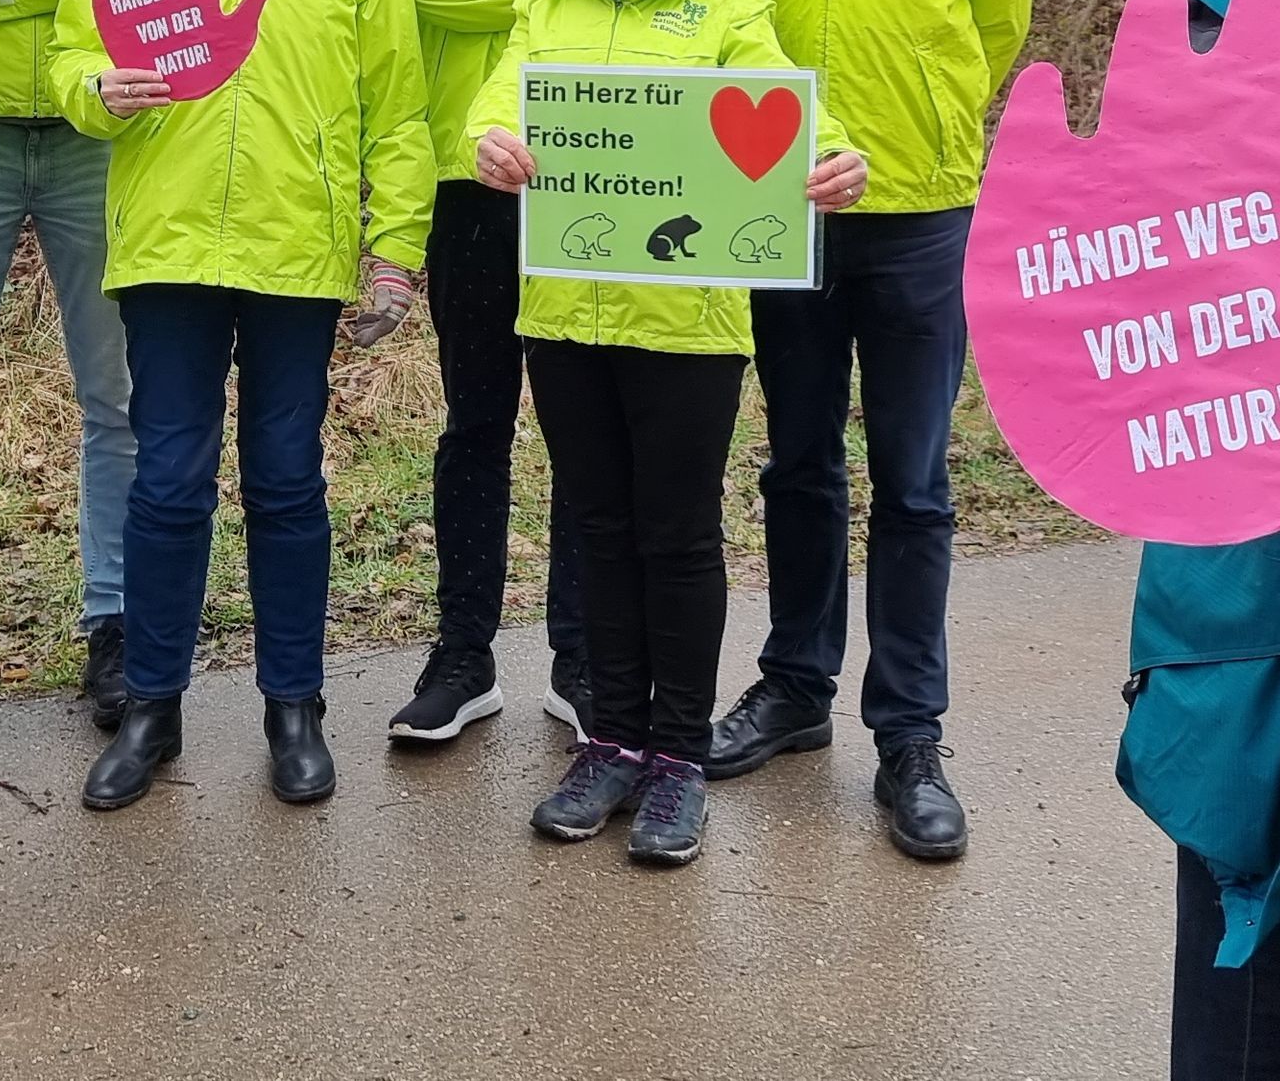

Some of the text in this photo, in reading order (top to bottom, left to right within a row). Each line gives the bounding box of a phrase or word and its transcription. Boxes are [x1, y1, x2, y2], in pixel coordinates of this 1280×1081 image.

[135, 7, 204, 45] VON DER
[655, 11, 682, 20] BUND
[154, 42, 212, 77] NATUR!
[525, 79, 684, 105] Ein Herz für
[525, 125, 634, 150] Frösche
[527, 172, 684, 198] und Kröten!
[1015, 190, 1279, 299] HÄNDE WEG
[1083, 287, 1280, 380] VON DER
